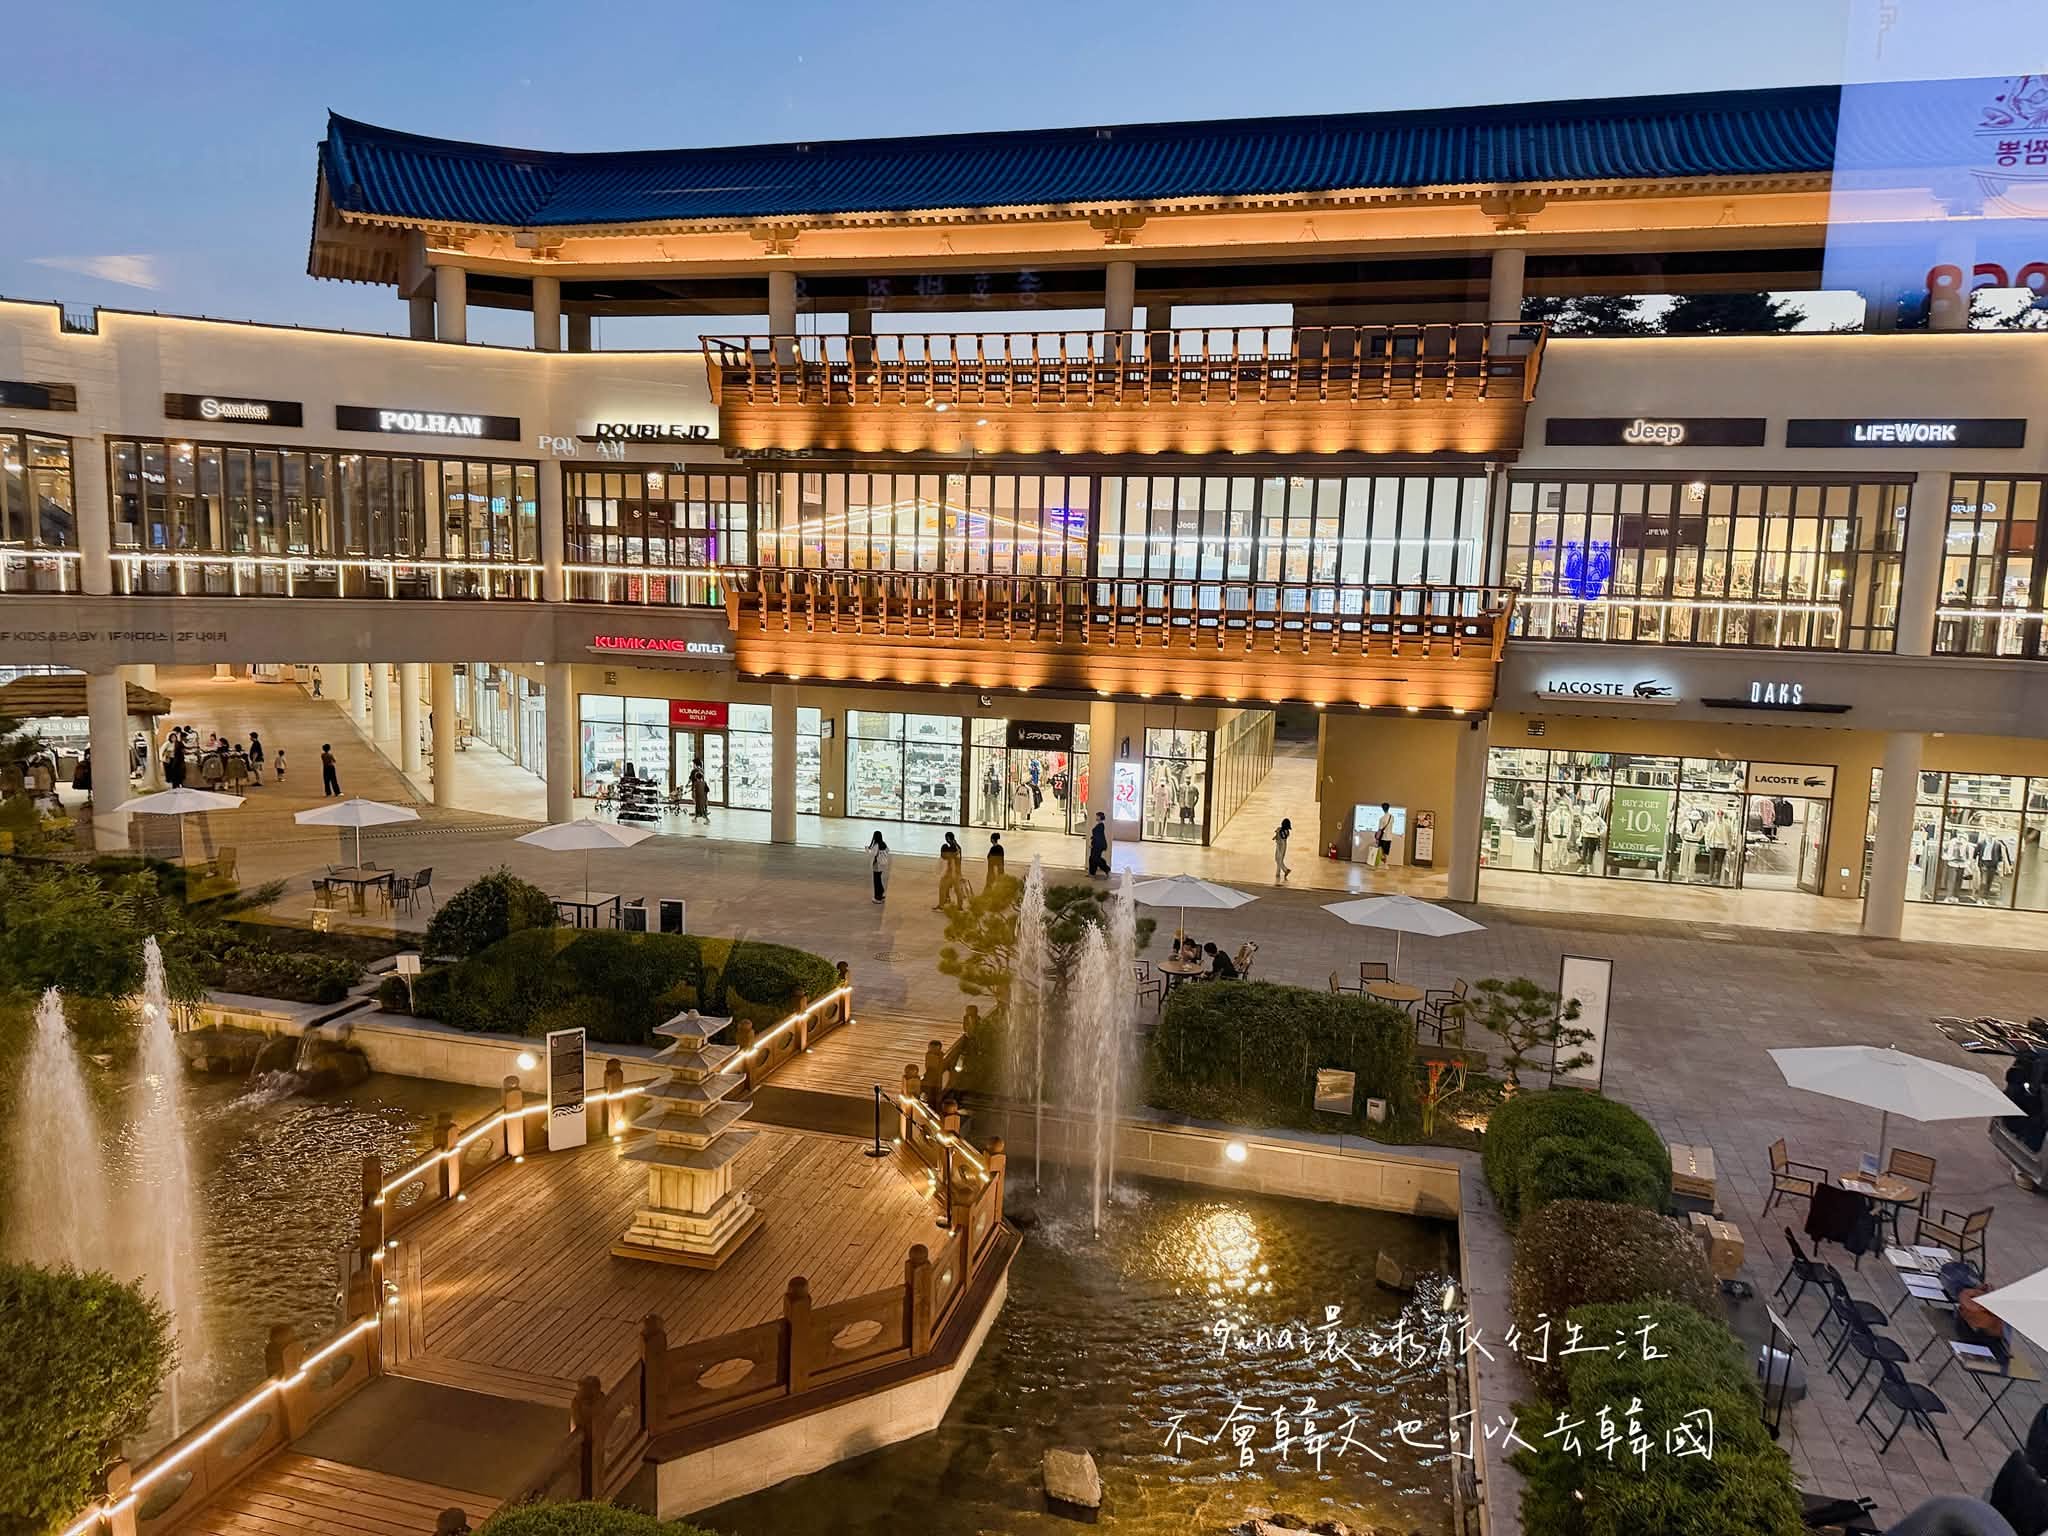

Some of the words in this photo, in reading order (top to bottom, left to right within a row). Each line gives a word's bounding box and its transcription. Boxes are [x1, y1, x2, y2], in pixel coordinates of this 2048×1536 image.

[379, 410, 482, 435] POLHAM
[1624, 419, 1684, 445] Jeep
[1854, 423, 1957, 442] LIFEWORK
[595, 636, 685, 652] KUMKANG
[686, 642, 726, 654] OUTLET
[1548, 680, 1625, 696] LACOSTE
[1751, 682, 1803, 704] DAKS
[1026, 732, 1062, 740] SPYDER
[1755, 775, 1799, 784] LACOSTE
[1622, 800, 1638, 808] BUY
[1644, 801, 1660, 809] GET
[1612, 842, 1645, 851] LACOSTE
